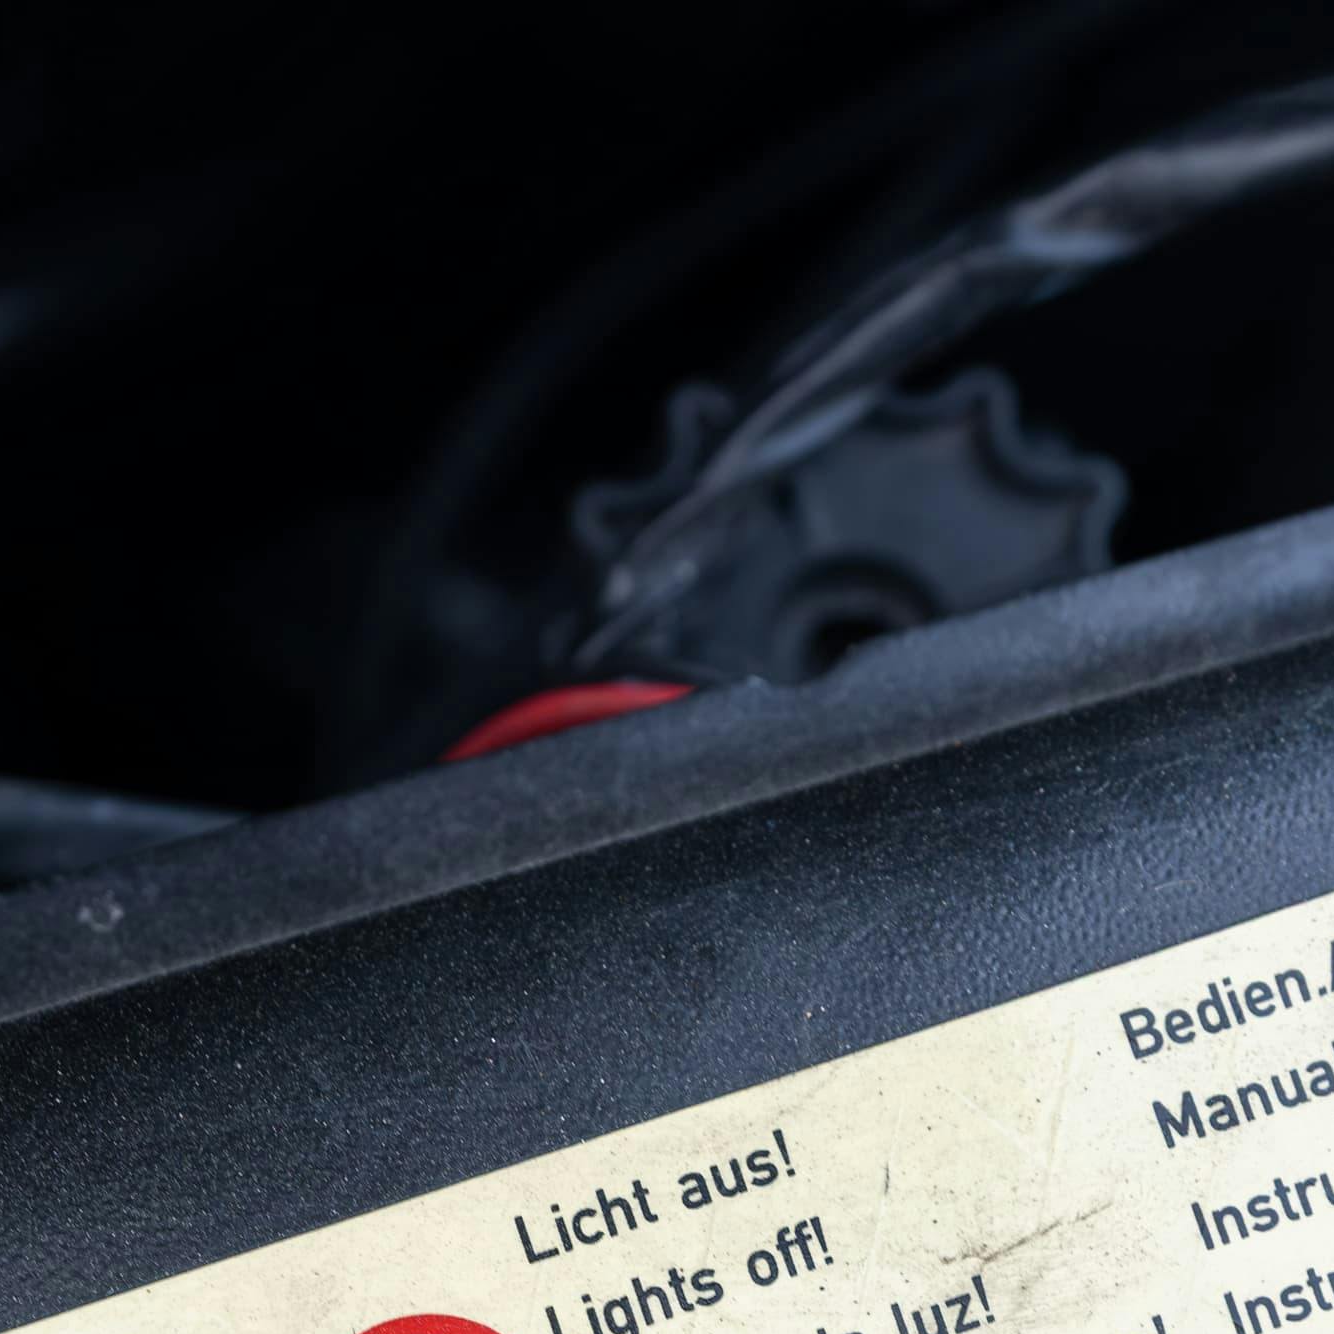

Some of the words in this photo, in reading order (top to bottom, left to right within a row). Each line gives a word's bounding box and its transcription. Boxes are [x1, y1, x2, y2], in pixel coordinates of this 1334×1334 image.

[515, 1180, 658, 1264] Licht
[680, 1129, 795, 1209] aus!
[747, 1217, 833, 1286] off!
